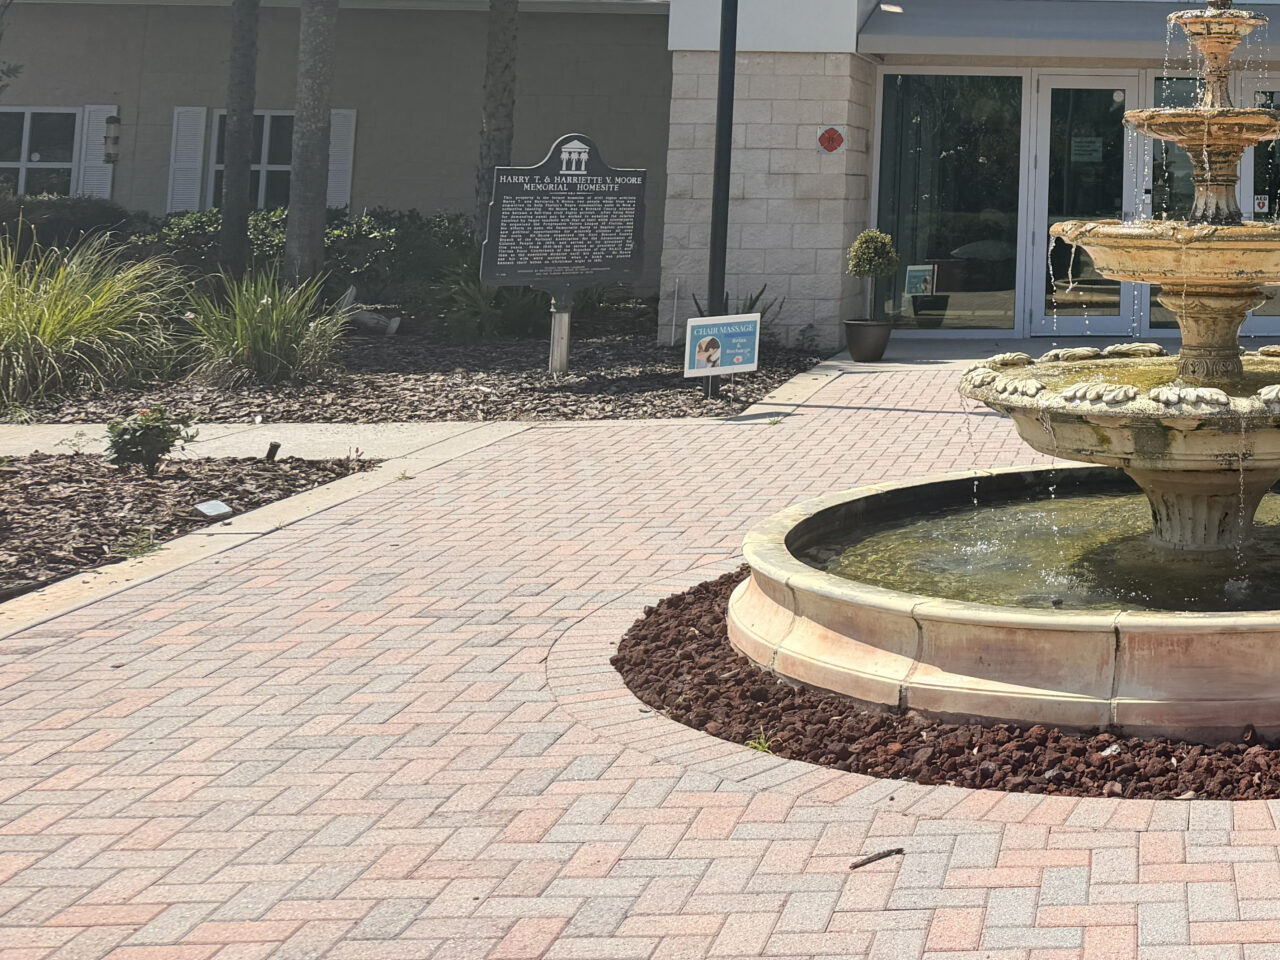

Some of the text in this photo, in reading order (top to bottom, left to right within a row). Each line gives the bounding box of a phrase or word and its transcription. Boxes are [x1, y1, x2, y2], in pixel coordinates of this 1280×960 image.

[554, 176, 603, 184] HARRIETTE
[606, 176, 612, 184] V.
[614, 176, 643, 184] MOORE
[523, 183, 620, 191] MEMORIAL HOMESITE
[694, 324, 754, 335] CHAIR MASSAGE
